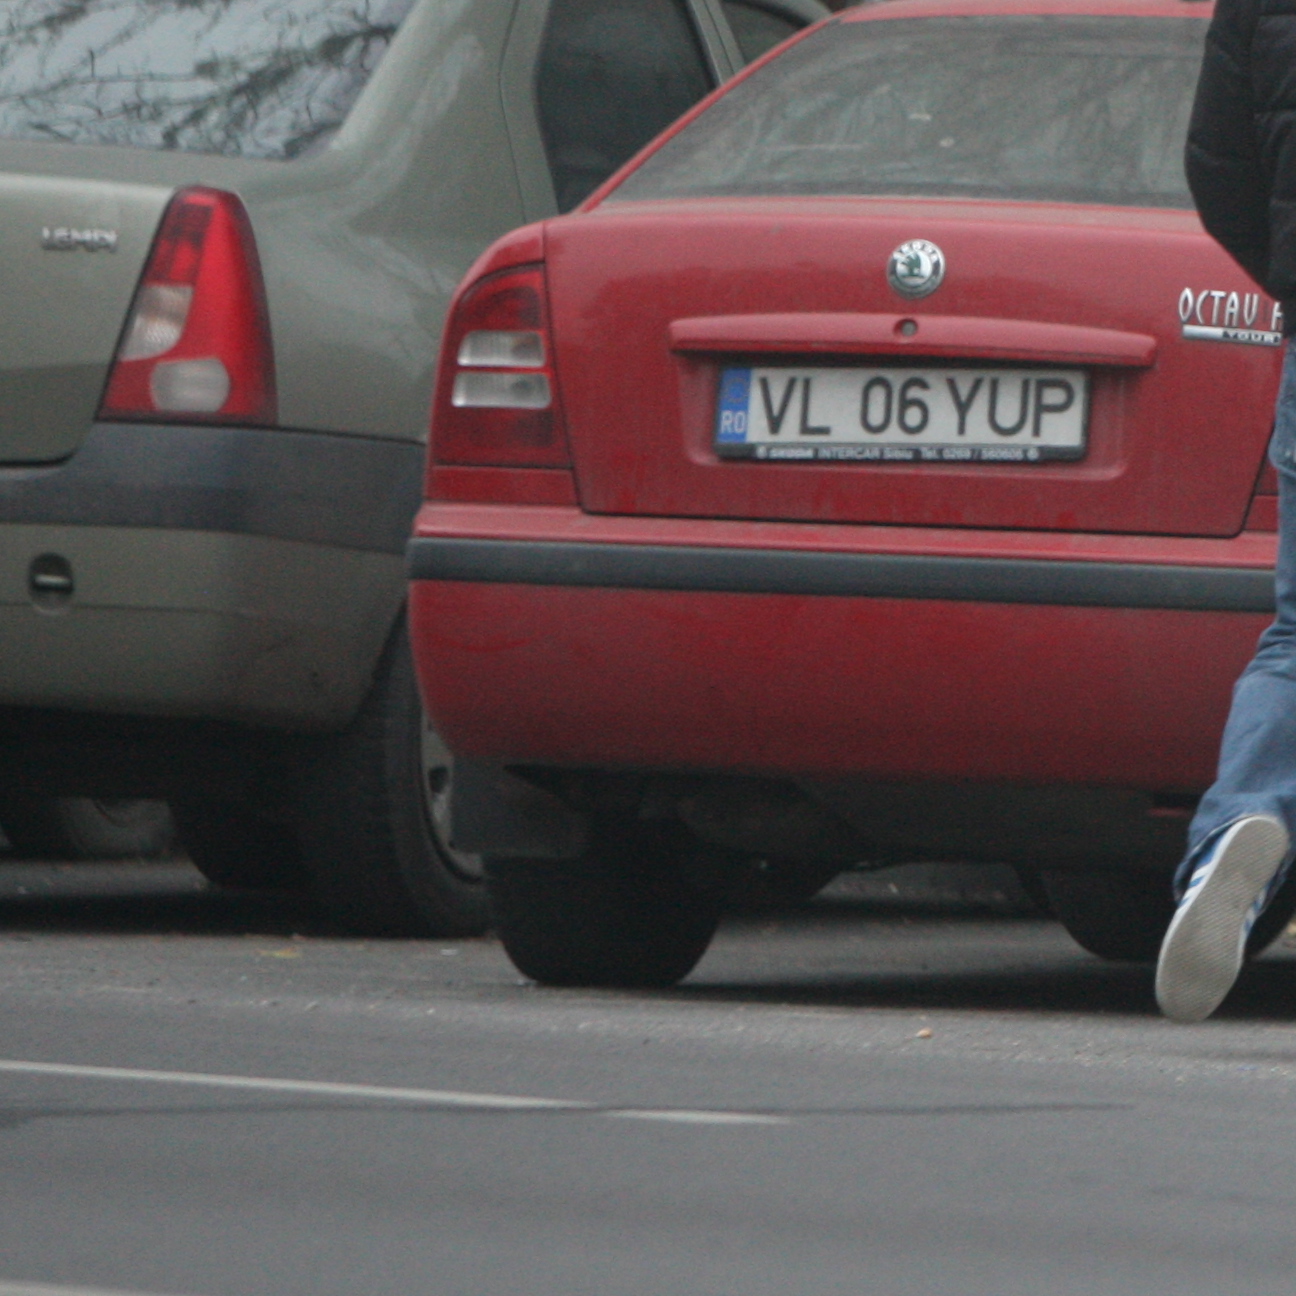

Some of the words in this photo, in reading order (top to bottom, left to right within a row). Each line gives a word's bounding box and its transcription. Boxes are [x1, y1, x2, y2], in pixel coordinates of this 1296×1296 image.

[719, 410, 747, 434] RO
[758, 376, 831, 436] VL
[860, 375, 930, 435] 06
[946, 377, 1076, 438] YUP
